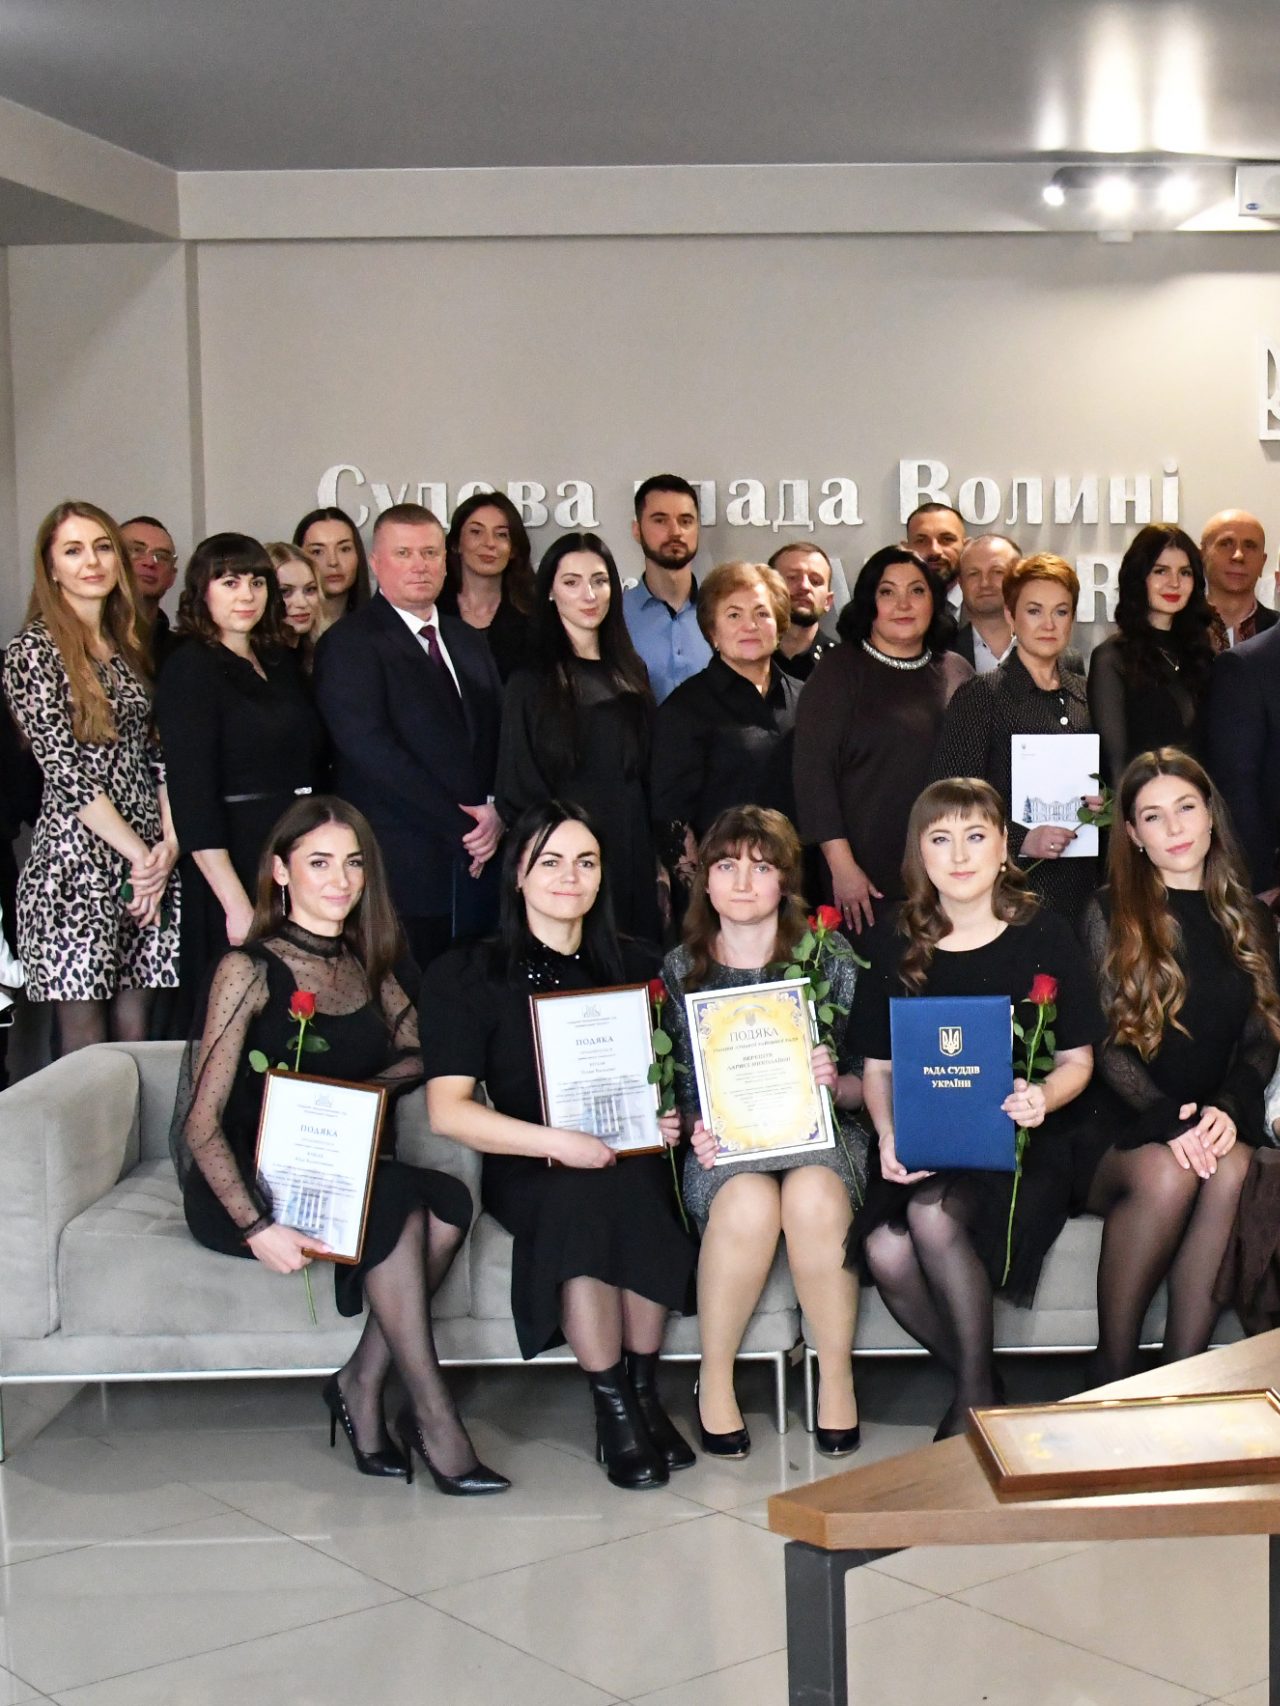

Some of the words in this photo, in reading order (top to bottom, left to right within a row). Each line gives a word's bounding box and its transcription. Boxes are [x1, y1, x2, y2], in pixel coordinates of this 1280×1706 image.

[634, 477, 864, 533] лада
[899, 457, 1179, 525] Волині
[730, 1027, 779, 1042] ПОДЯКА
[575, 1035, 614, 1047] ПОДЯКА
[923, 1066, 946, 1075] РАДА
[948, 1066, 980, 1075] СУДДІВ
[932, 1078, 972, 1088] УКРАЇНИ
